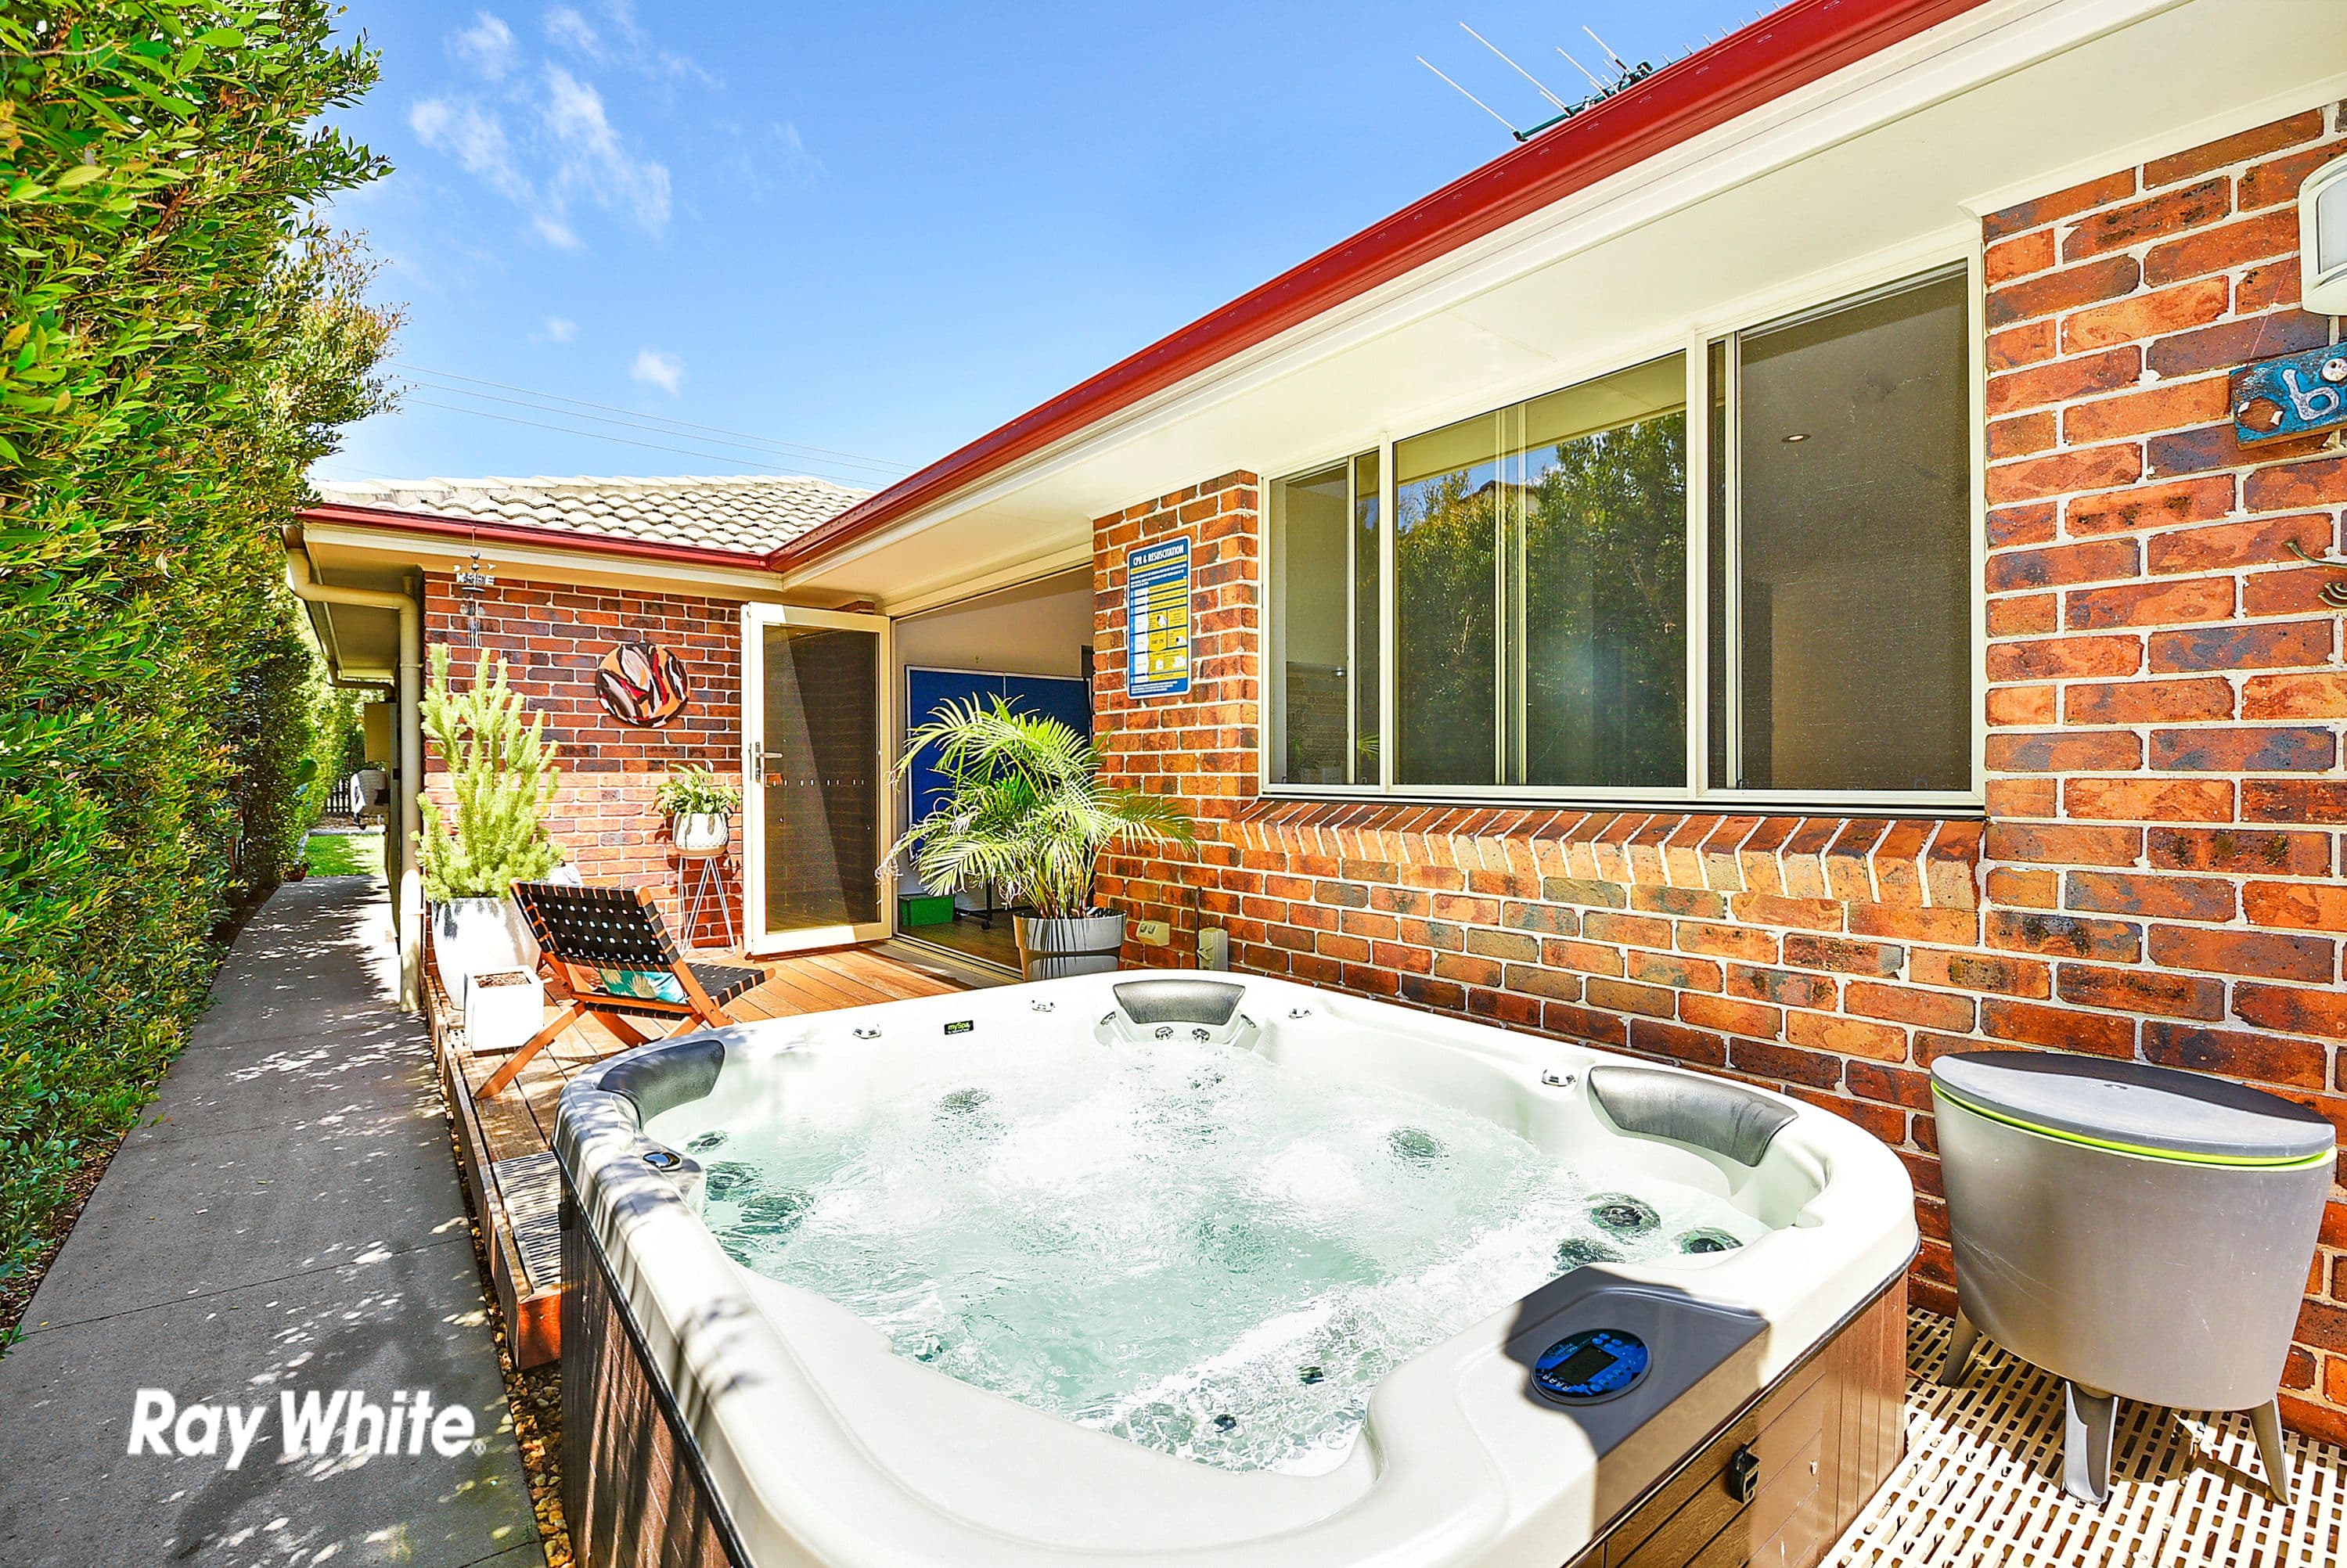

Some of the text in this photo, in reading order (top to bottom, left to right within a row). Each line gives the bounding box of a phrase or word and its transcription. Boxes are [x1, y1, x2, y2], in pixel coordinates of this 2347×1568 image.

[1133, 555, 1143, 566] CPR
[1143, 554, 1147, 563] &
[1148, 544, 1184, 563] RESUSCITATION
[948, 1021, 970, 1032] mySpa
